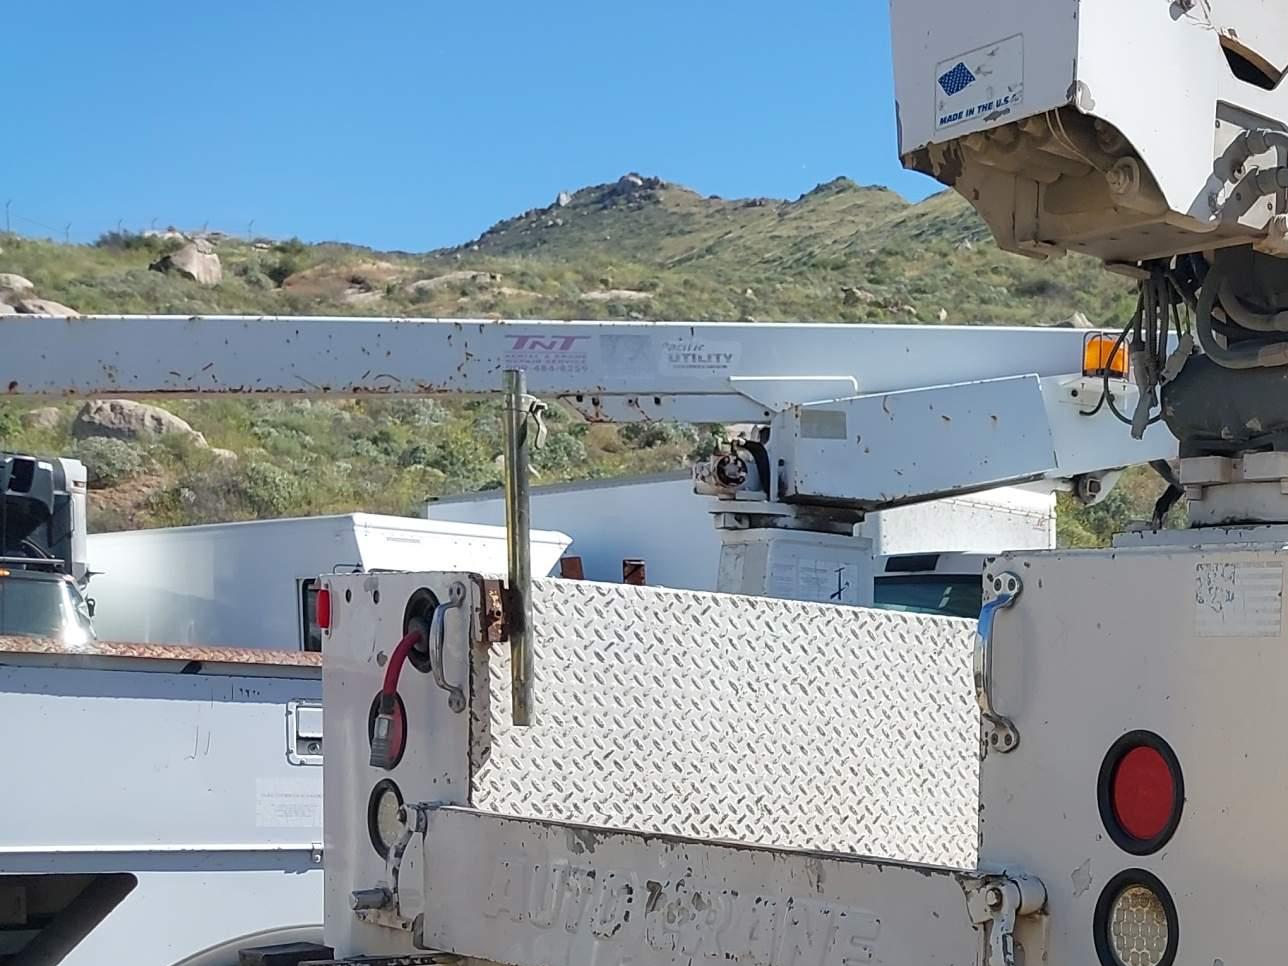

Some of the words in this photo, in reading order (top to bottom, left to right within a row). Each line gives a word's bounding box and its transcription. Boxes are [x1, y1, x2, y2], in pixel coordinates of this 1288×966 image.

[940, 111, 964, 125] MADE
[965, 107, 975, 117] IN
[977, 101, 994, 113] THE
[504, 335, 591, 350] TNT
[669, 353, 733, 363] UTILITY
[483, 856, 634, 939] AUTO
